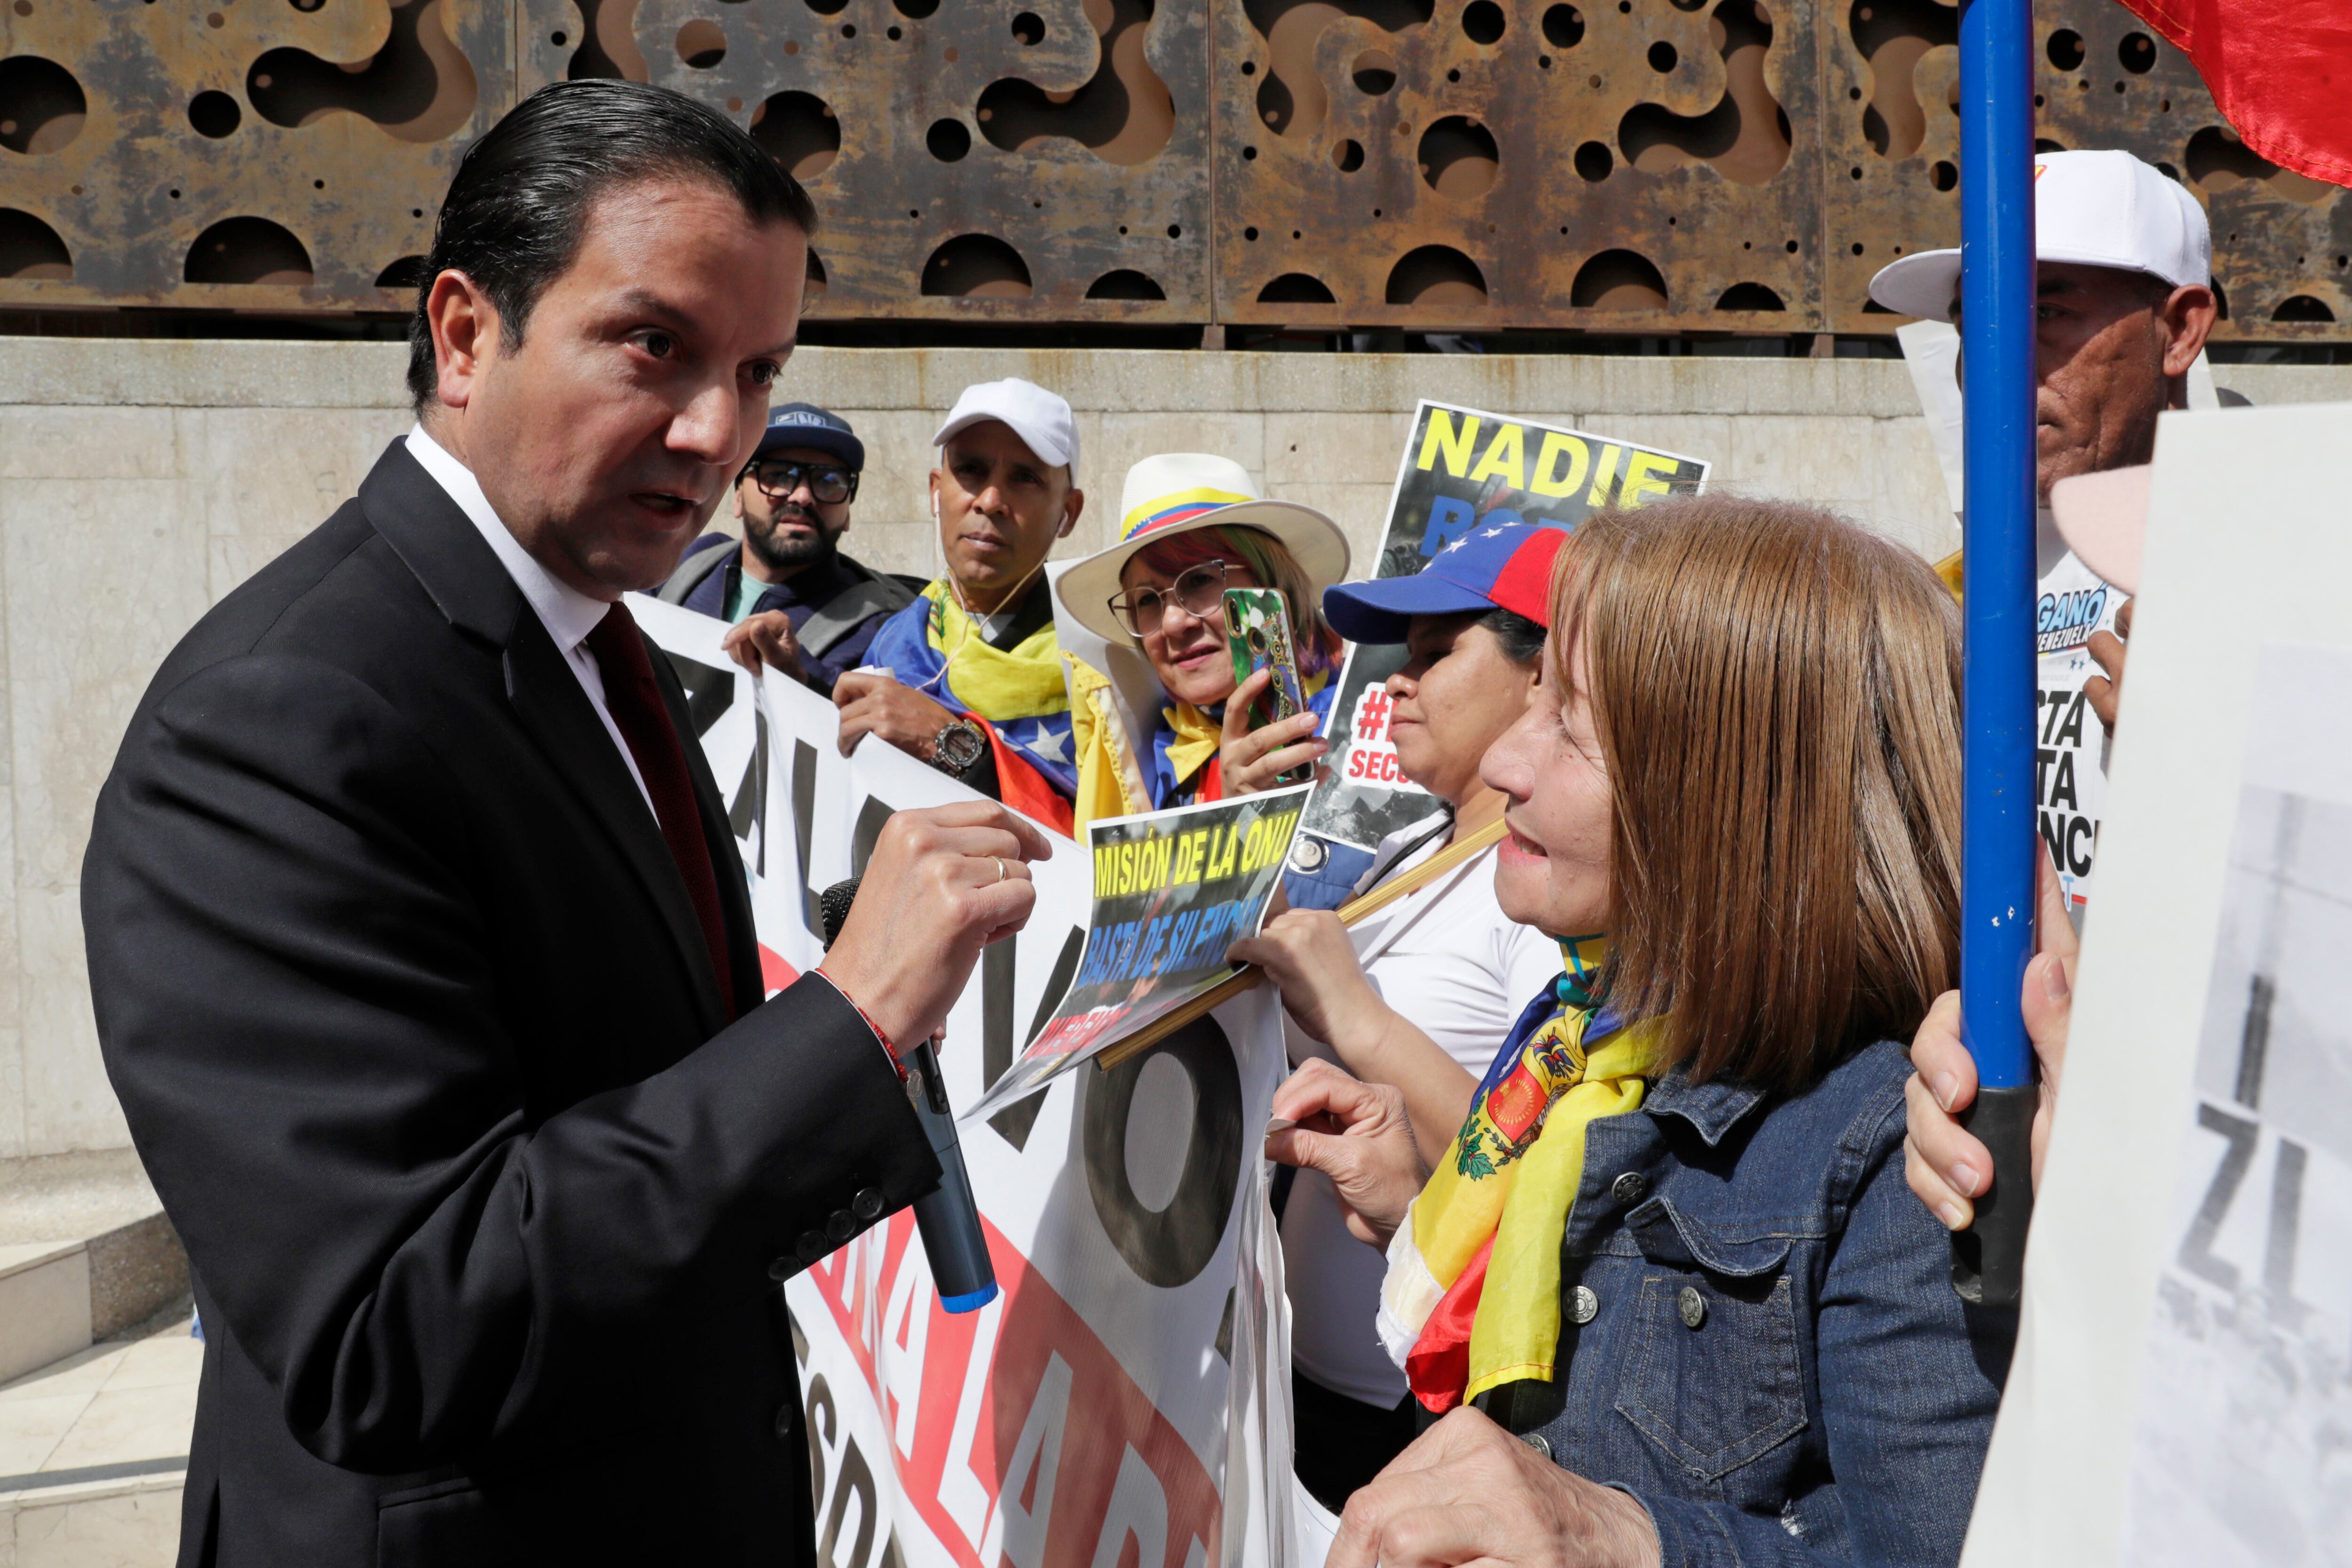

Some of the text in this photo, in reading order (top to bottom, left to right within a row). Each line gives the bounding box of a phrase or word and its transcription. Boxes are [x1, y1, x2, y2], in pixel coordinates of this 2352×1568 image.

[1417, 408, 1679, 511] NADIE
[1095, 812, 1297, 898] MISIÓN DE LA ONU
[1074, 921, 1143, 987] BASTA
[1129, 915, 1173, 979] DE
